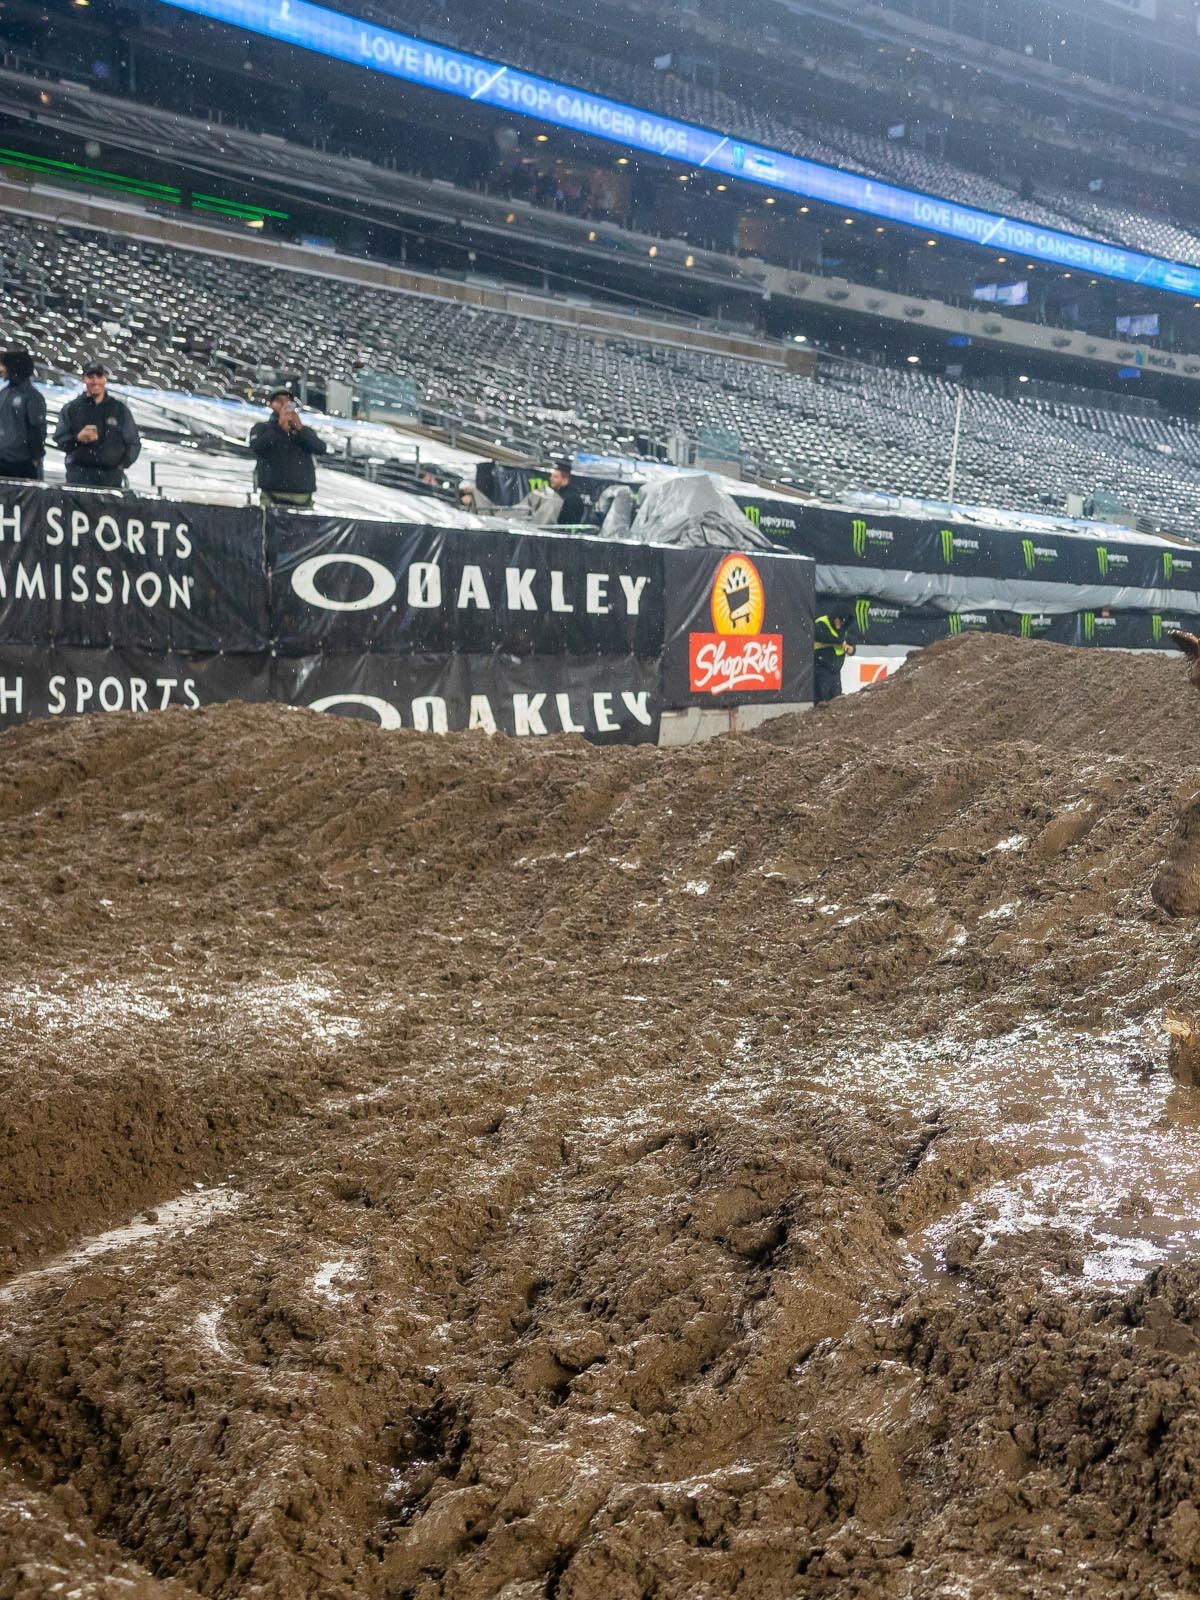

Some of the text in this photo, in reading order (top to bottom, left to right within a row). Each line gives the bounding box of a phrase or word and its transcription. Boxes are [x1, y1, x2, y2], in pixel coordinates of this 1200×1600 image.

[359, 31, 688, 152] LOVE MOTO STOP CANCER RACE
[913, 201, 1127, 273] LOVE MOTO STOP CANCER RACE
[46, 507, 193, 559] SPORTS
[760, 516, 796, 530] MONSTER
[866, 528, 894, 541] MONSTER
[0, 562, 192, 610] MISSION
[407, 561, 649, 615] OAKLEY
[694, 640, 779, 689] ShopRite
[47, 676, 201, 715] SPORTS
[411, 691, 652, 736] OAKLEY
